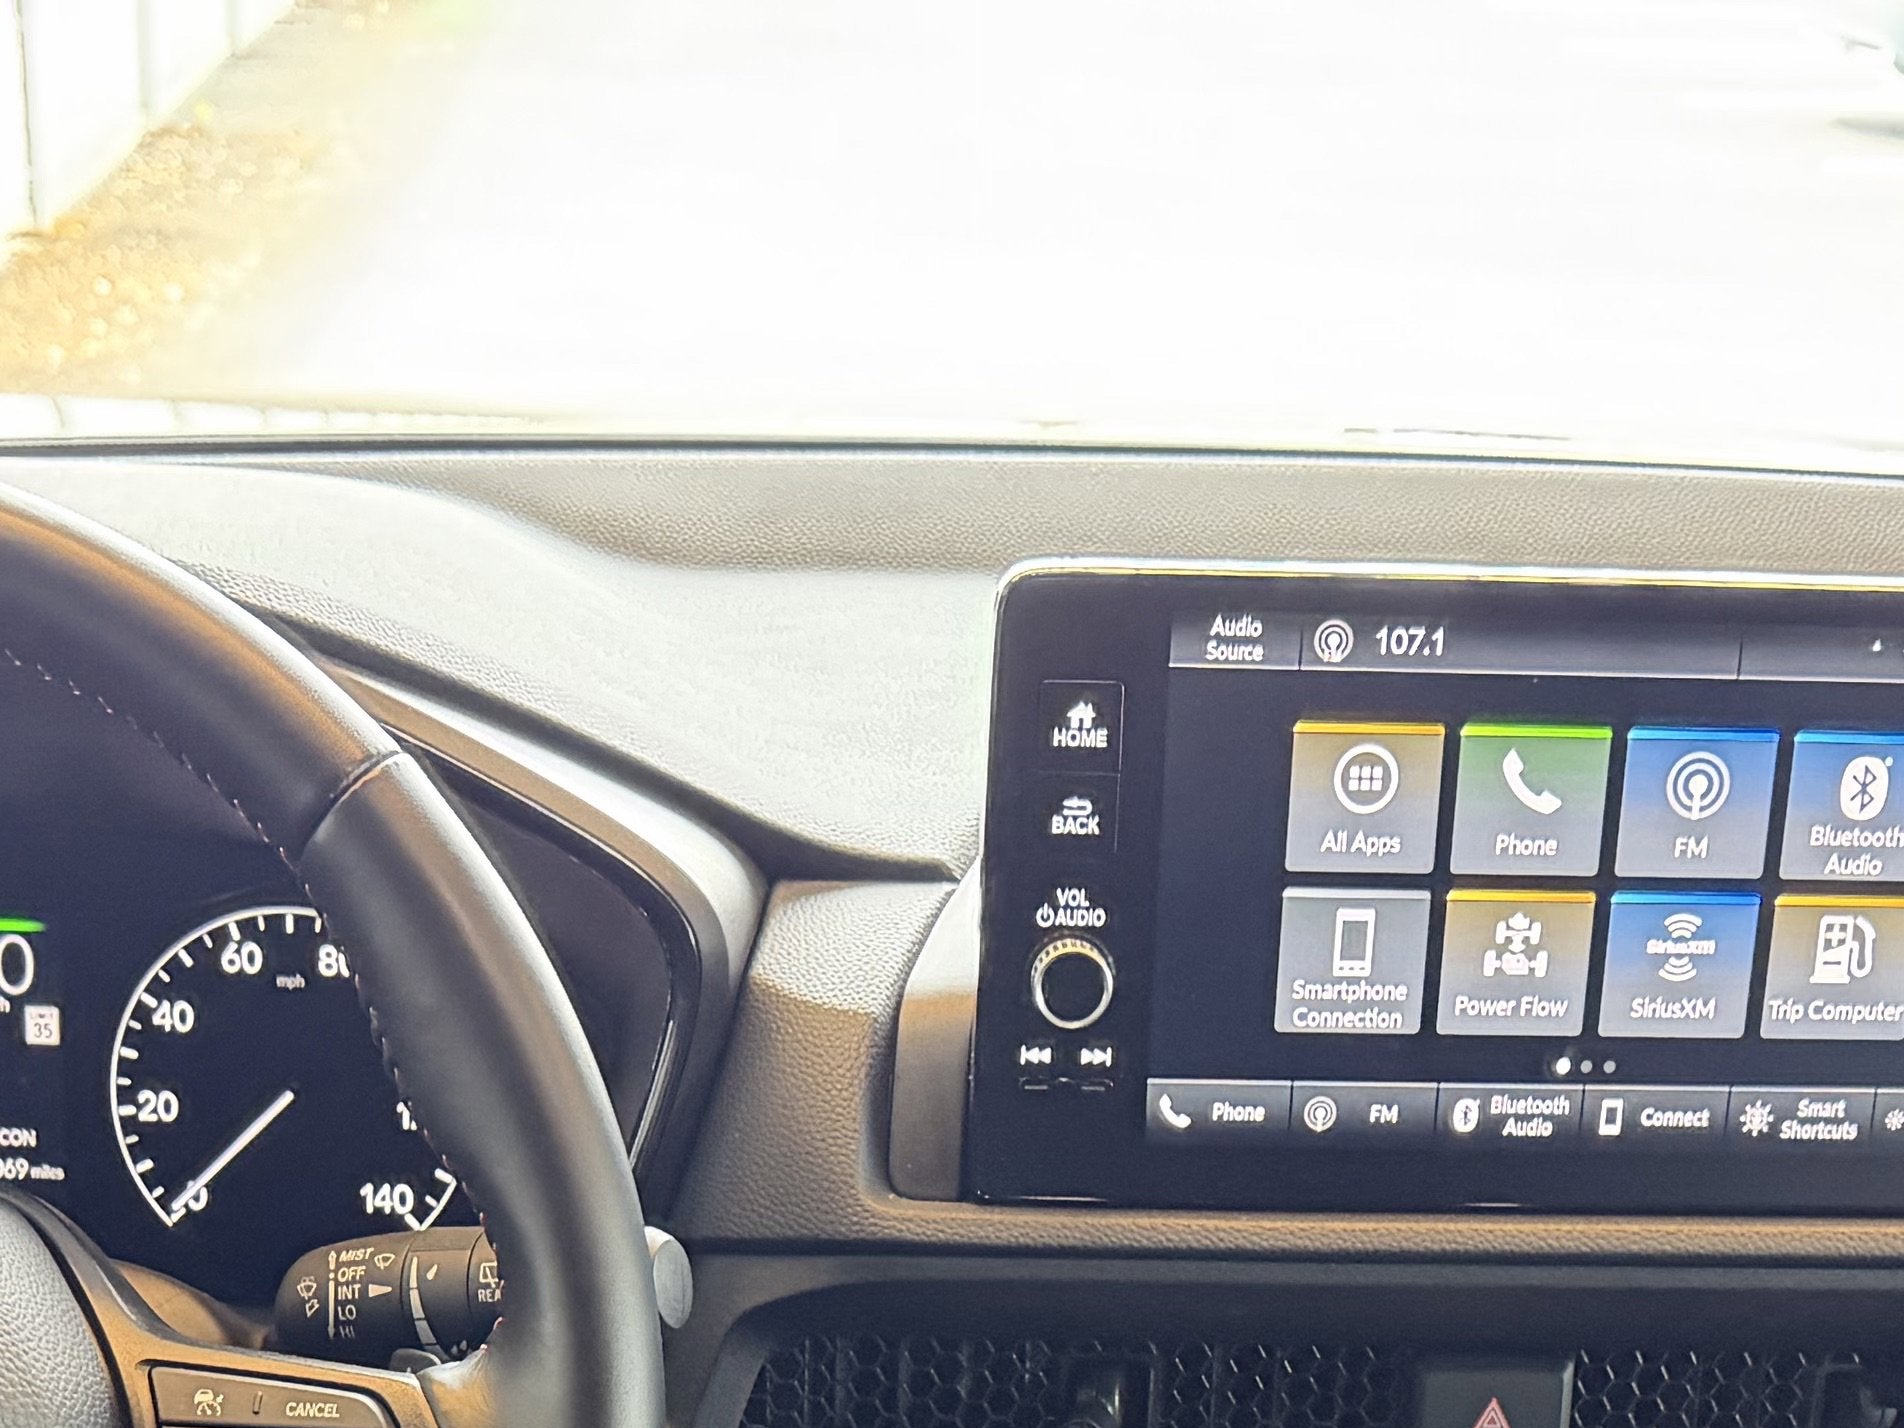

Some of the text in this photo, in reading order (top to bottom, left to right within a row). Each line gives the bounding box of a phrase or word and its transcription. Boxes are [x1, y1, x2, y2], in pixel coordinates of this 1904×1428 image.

[1210, 614, 1263, 637] Audio
[1376, 625, 1444, 656] 107.1
[1205, 642, 1264, 661] Source
[1052, 727, 1108, 748] HOME
[1051, 814, 1100, 835] BACK
[1320, 830, 1401, 856] All Apps
[1495, 833, 1558, 856] Phone
[1810, 825, 1904, 849] Bluetooth
[1674, 837, 1708, 859] FM
[1824, 854, 1882, 877] Audio
[1056, 887, 1089, 907] VOL
[1054, 908, 1106, 928] AUDIO
[221, 941, 263, 975] 60
[276, 974, 306, 990] mph
[1292, 980, 1408, 1004] Smartphone
[152, 1000, 195, 1033] 40
[1455, 996, 1568, 1018] Power Flow
[1628, 996, 1716, 1020] SiriusXM
[1768, 999, 1904, 1024] Trip Computer
[1293, 1007, 1403, 1029] Connection
[34, 1023, 53, 1039] 35
[137, 1089, 179, 1124] 20
[1212, 1102, 1266, 1123] Phone
[1369, 1104, 1399, 1124] FM
[1490, 1095, 1570, 1116] Bluetooth
[1797, 1098, 1846, 1119] Smart
[1501, 1117, 1553, 1138] Audio
[1640, 1107, 1710, 1128] Connect
[1779, 1119, 1858, 1140] Shortcuts
[359, 1183, 414, 1214] 140
[339, 1248, 374, 1261] MIST
[338, 1267, 366, 1282] OFF
[338, 1284, 361, 1300] INT
[478, 1289, 501, 1303] REA
[338, 1304, 356, 1320] LO
[286, 1402, 340, 1418] CANCEL
